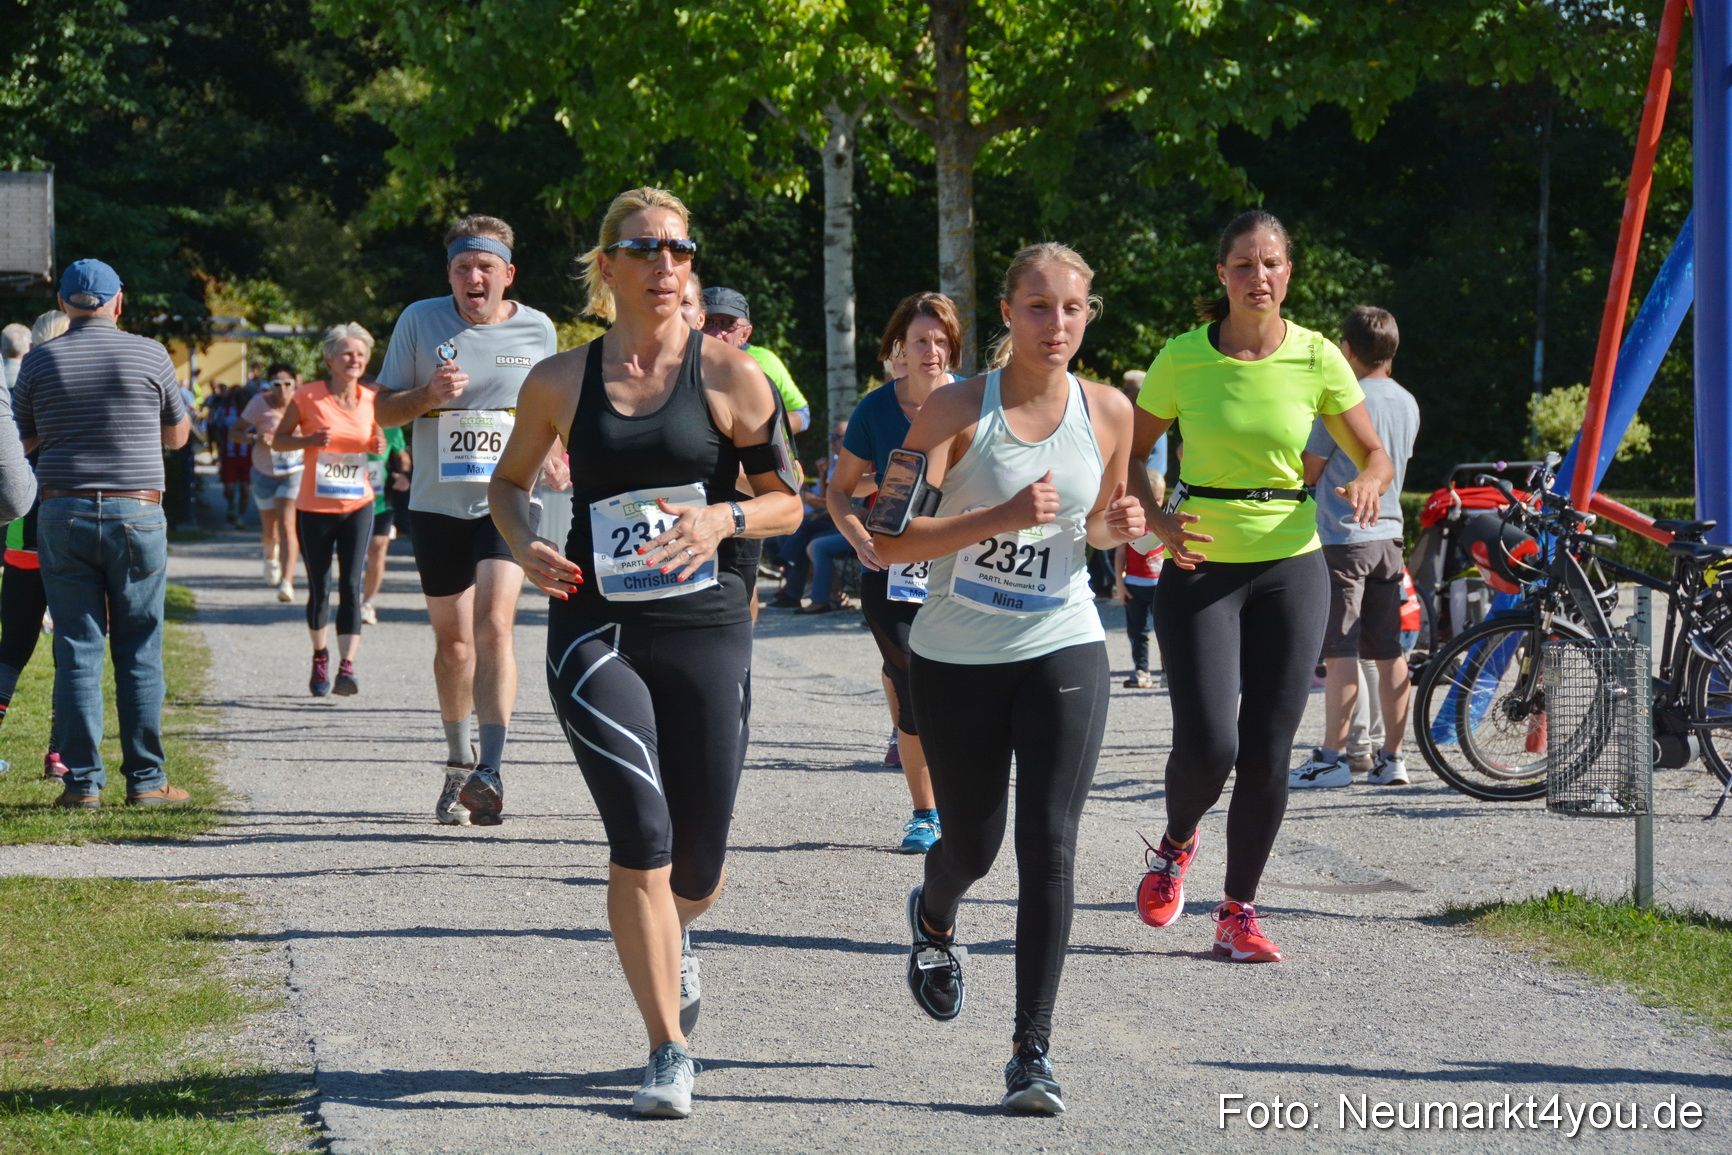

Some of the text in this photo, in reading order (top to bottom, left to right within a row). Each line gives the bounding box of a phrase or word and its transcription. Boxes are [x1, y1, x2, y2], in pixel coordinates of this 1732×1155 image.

[496, 356, 532, 366] BOCK
[449, 431, 502, 452] 2026
[324, 464, 359, 478] 2007
[467, 464, 485, 474] Max
[611, 518, 679, 558] 231
[621, 559, 647, 568] PARTL
[974, 537, 1051, 579] 2321
[979, 573, 1035, 590] PARTL Neumarkt
[992, 591, 1024, 609] Nina
